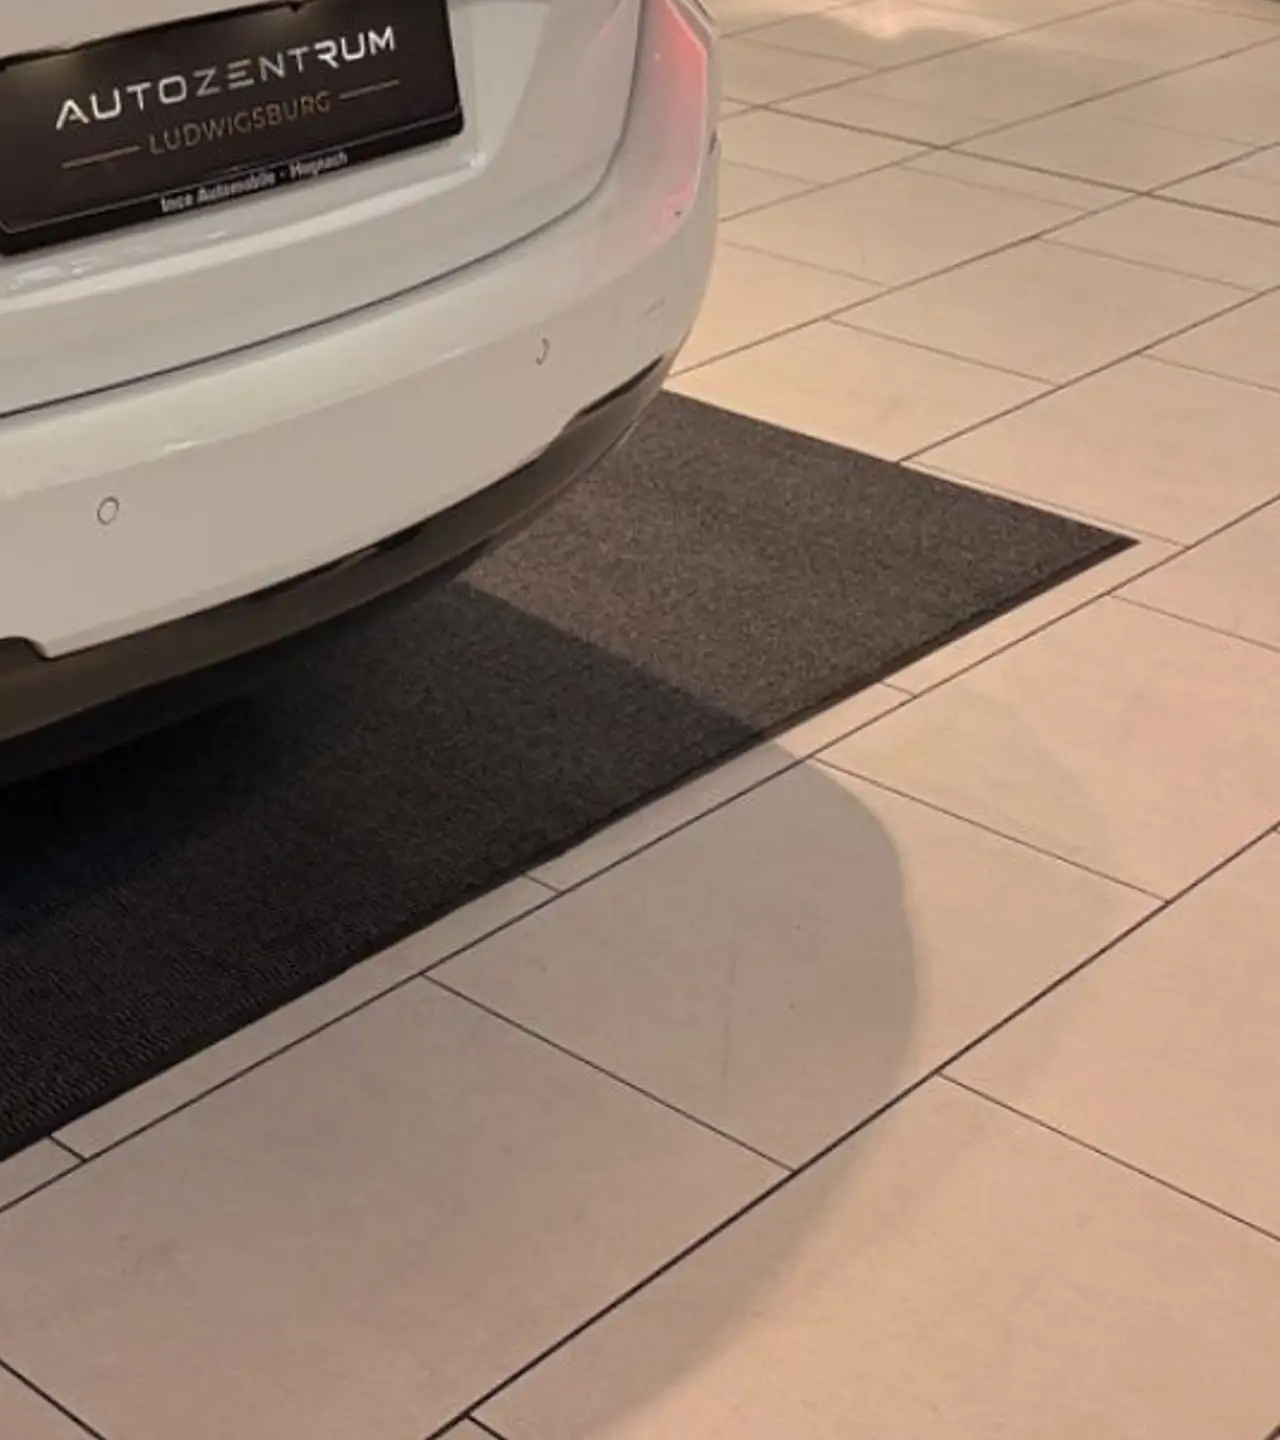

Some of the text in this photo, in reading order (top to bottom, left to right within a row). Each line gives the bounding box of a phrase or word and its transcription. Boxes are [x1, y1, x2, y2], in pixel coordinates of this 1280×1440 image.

[54, 25, 397, 131] AUTOZENTRUM
[148, 90, 332, 155] LUDWIGSBURG
[196, 170, 276, 204] Automobile
